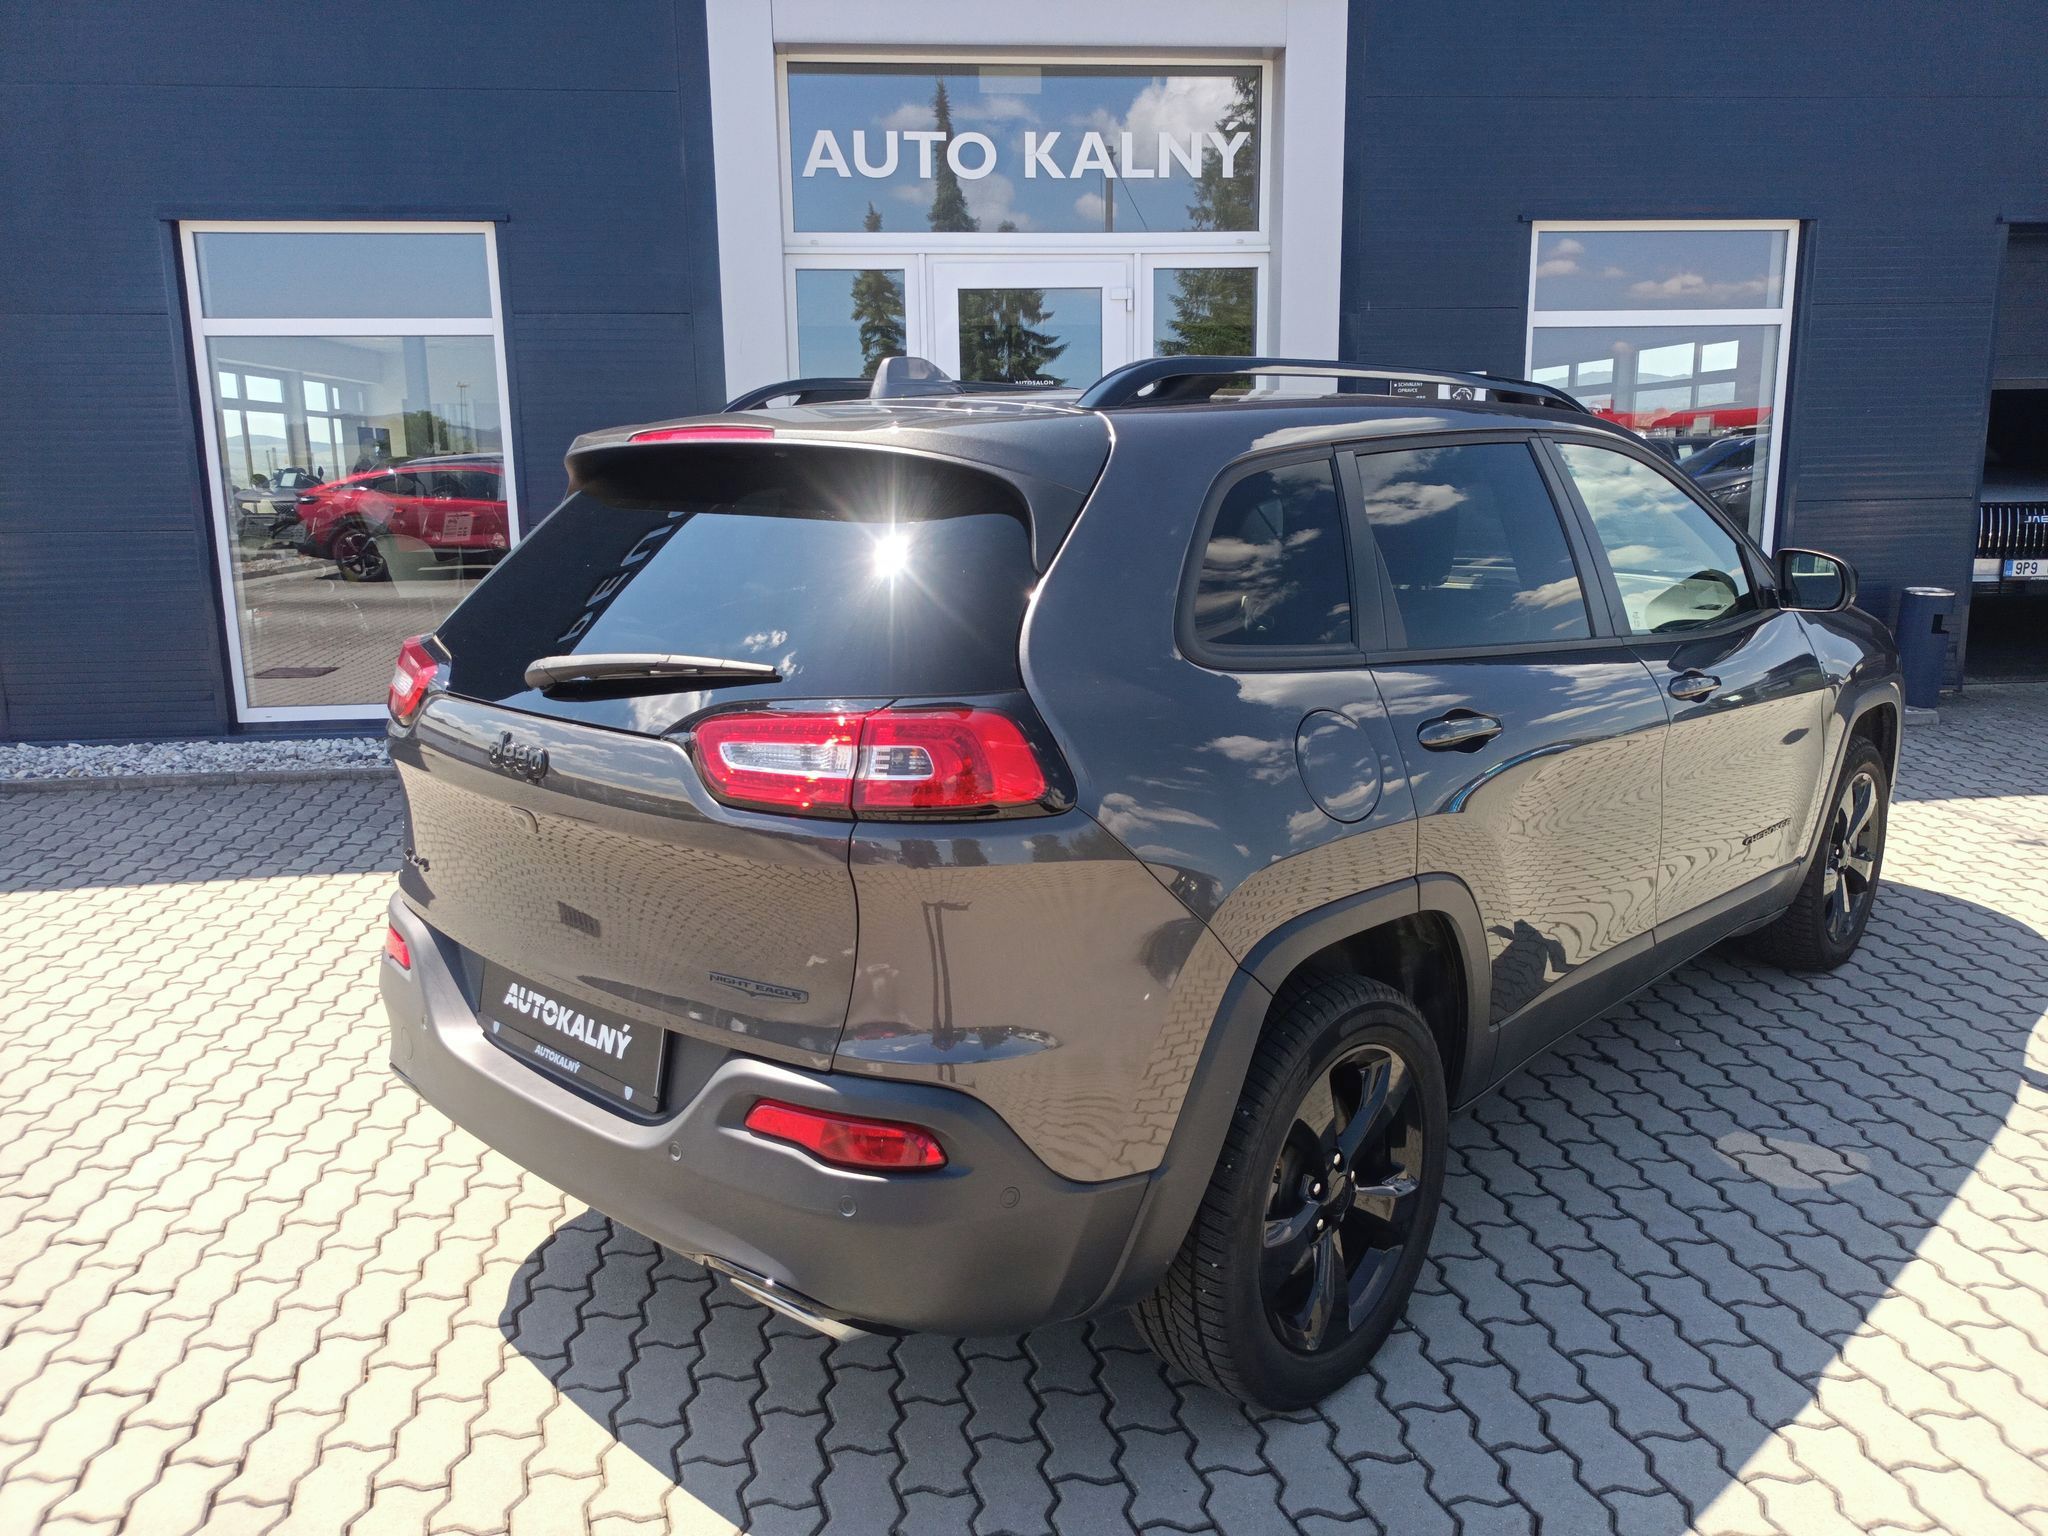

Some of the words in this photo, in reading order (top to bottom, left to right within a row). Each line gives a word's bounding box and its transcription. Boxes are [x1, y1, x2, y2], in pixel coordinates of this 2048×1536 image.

[802, 129, 998, 180] AUTO
[1023, 121, 1251, 179] KALNÝ
[1014, 379, 1055, 387] AUTOSALON
[2015, 561, 2038, 575] 9P9
[489, 731, 550, 784] Jeep
[709, 973, 751, 989] NIGHT
[755, 984, 802, 1001] EAGLE
[503, 982, 633, 1060] AUTOKALNÝ
[534, 1044, 582, 1074] AUTOKALNÝ
